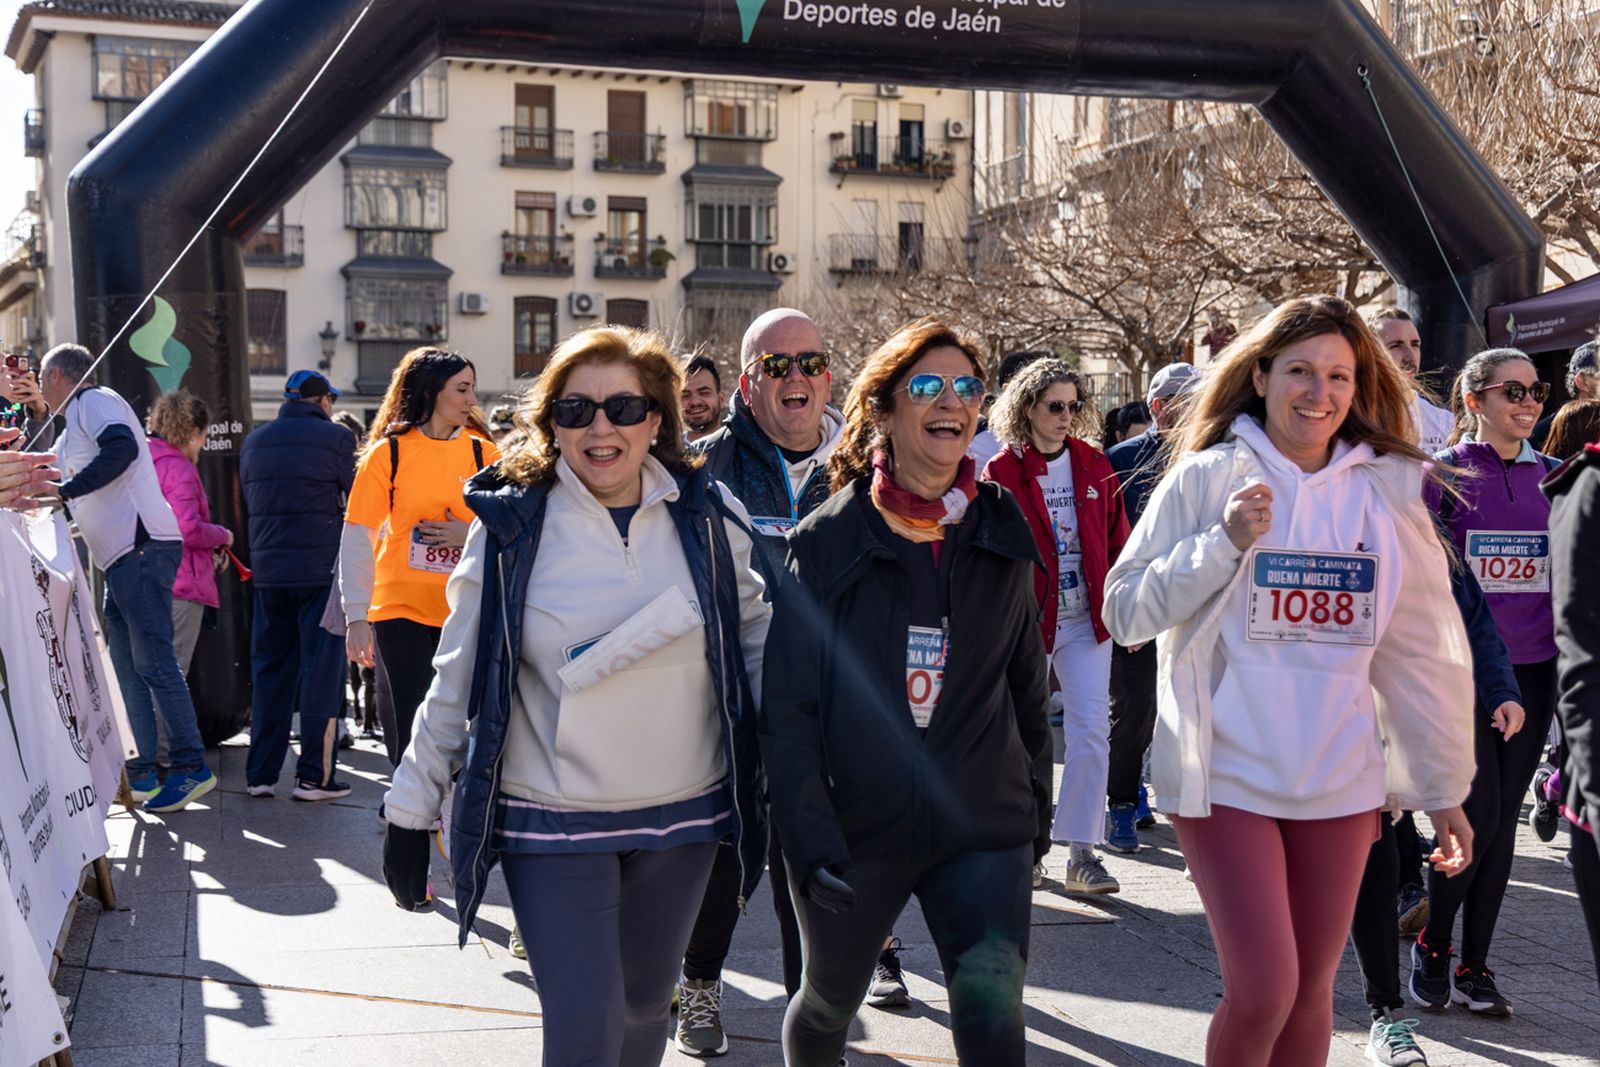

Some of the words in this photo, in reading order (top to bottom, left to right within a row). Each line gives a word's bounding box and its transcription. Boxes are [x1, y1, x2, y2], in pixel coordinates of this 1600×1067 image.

[782, 0, 898, 28] Deportes
[904, 5, 936, 29] de
[942, 8, 1001, 33] Jaén
[230, 421, 243, 433] de
[203, 436, 232, 451] Jaén
[1478, 545, 1500, 555] BUENA
[1501, 546, 1529, 555] MUERTE
[1279, 557, 1317, 568] CARRERA
[1318, 559, 1362, 571] CAMINATA
[1480, 557, 1536, 579] 1026
[1267, 570, 1300, 585] BUENA
[1302, 571, 1342, 587] MUERTE
[1270, 589, 1354, 625] 1088
